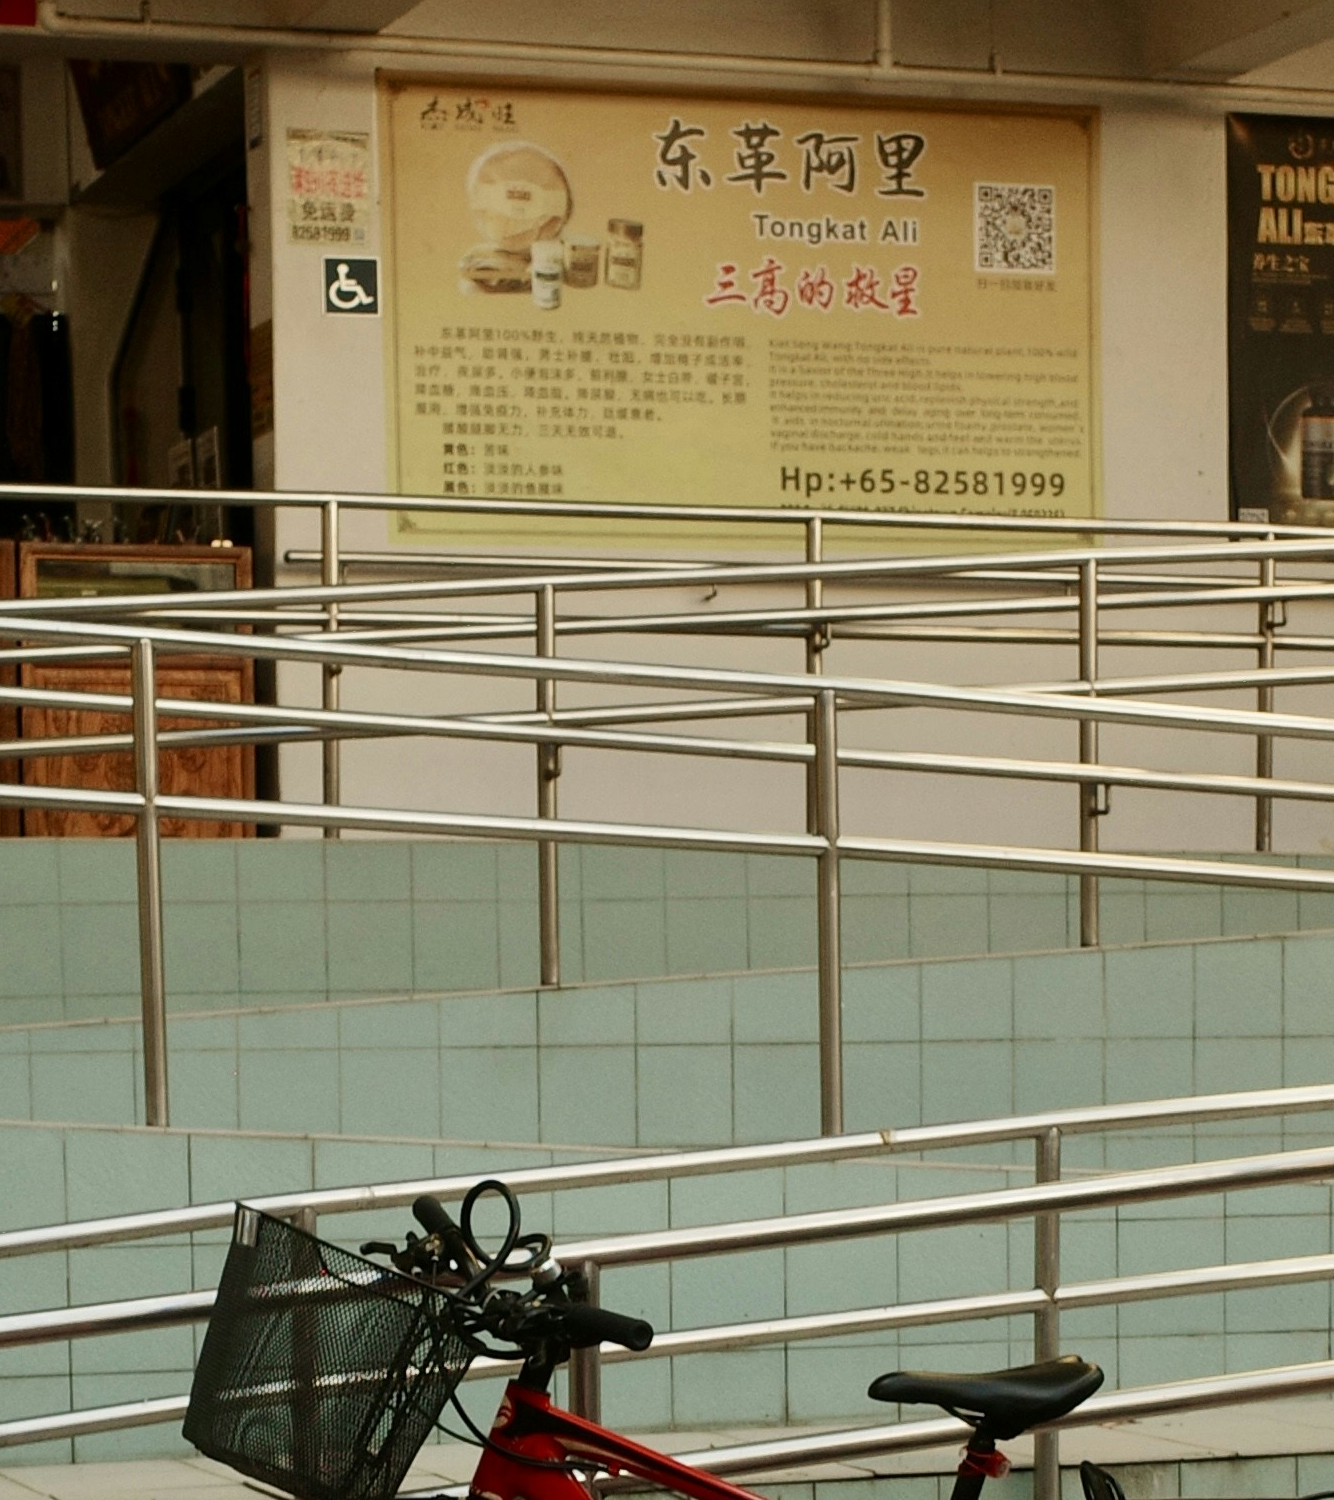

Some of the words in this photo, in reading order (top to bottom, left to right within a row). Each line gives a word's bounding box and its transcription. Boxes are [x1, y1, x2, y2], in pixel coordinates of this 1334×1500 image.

[654, 119, 926, 198] 东革阿里
[753, 214, 867, 245] Tongkat
[881, 219, 918, 243] Ali
[1257, 206, 1303, 245] ALI
[706, 258, 919, 316] 三高的救星
[780, 466, 1066, 497] Hp:+65-82581999
